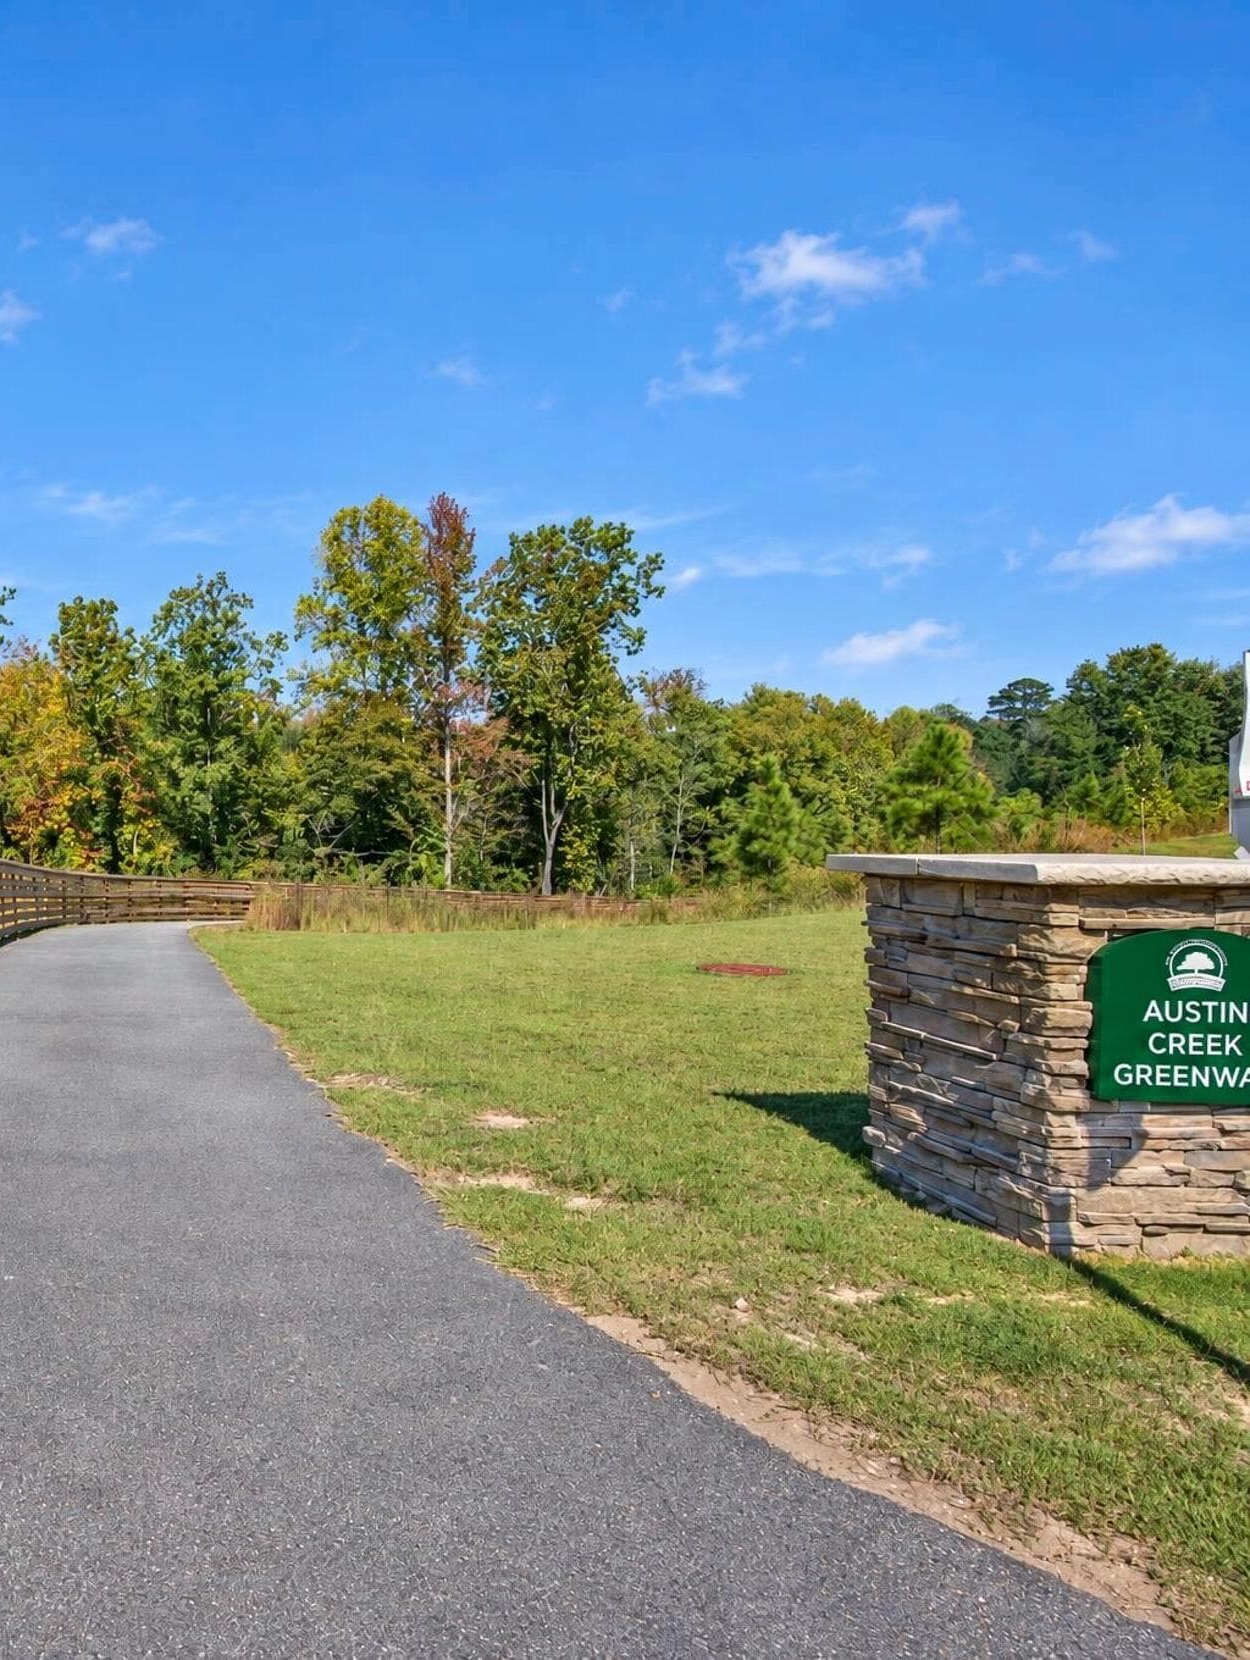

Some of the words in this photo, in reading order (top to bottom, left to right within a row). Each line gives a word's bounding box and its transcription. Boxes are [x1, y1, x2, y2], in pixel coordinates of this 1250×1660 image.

[1142, 999, 1248, 1024] AUSTIN
[1148, 1032, 1243, 1056] CREEK
[1113, 1063, 1250, 1088] GREENWA
